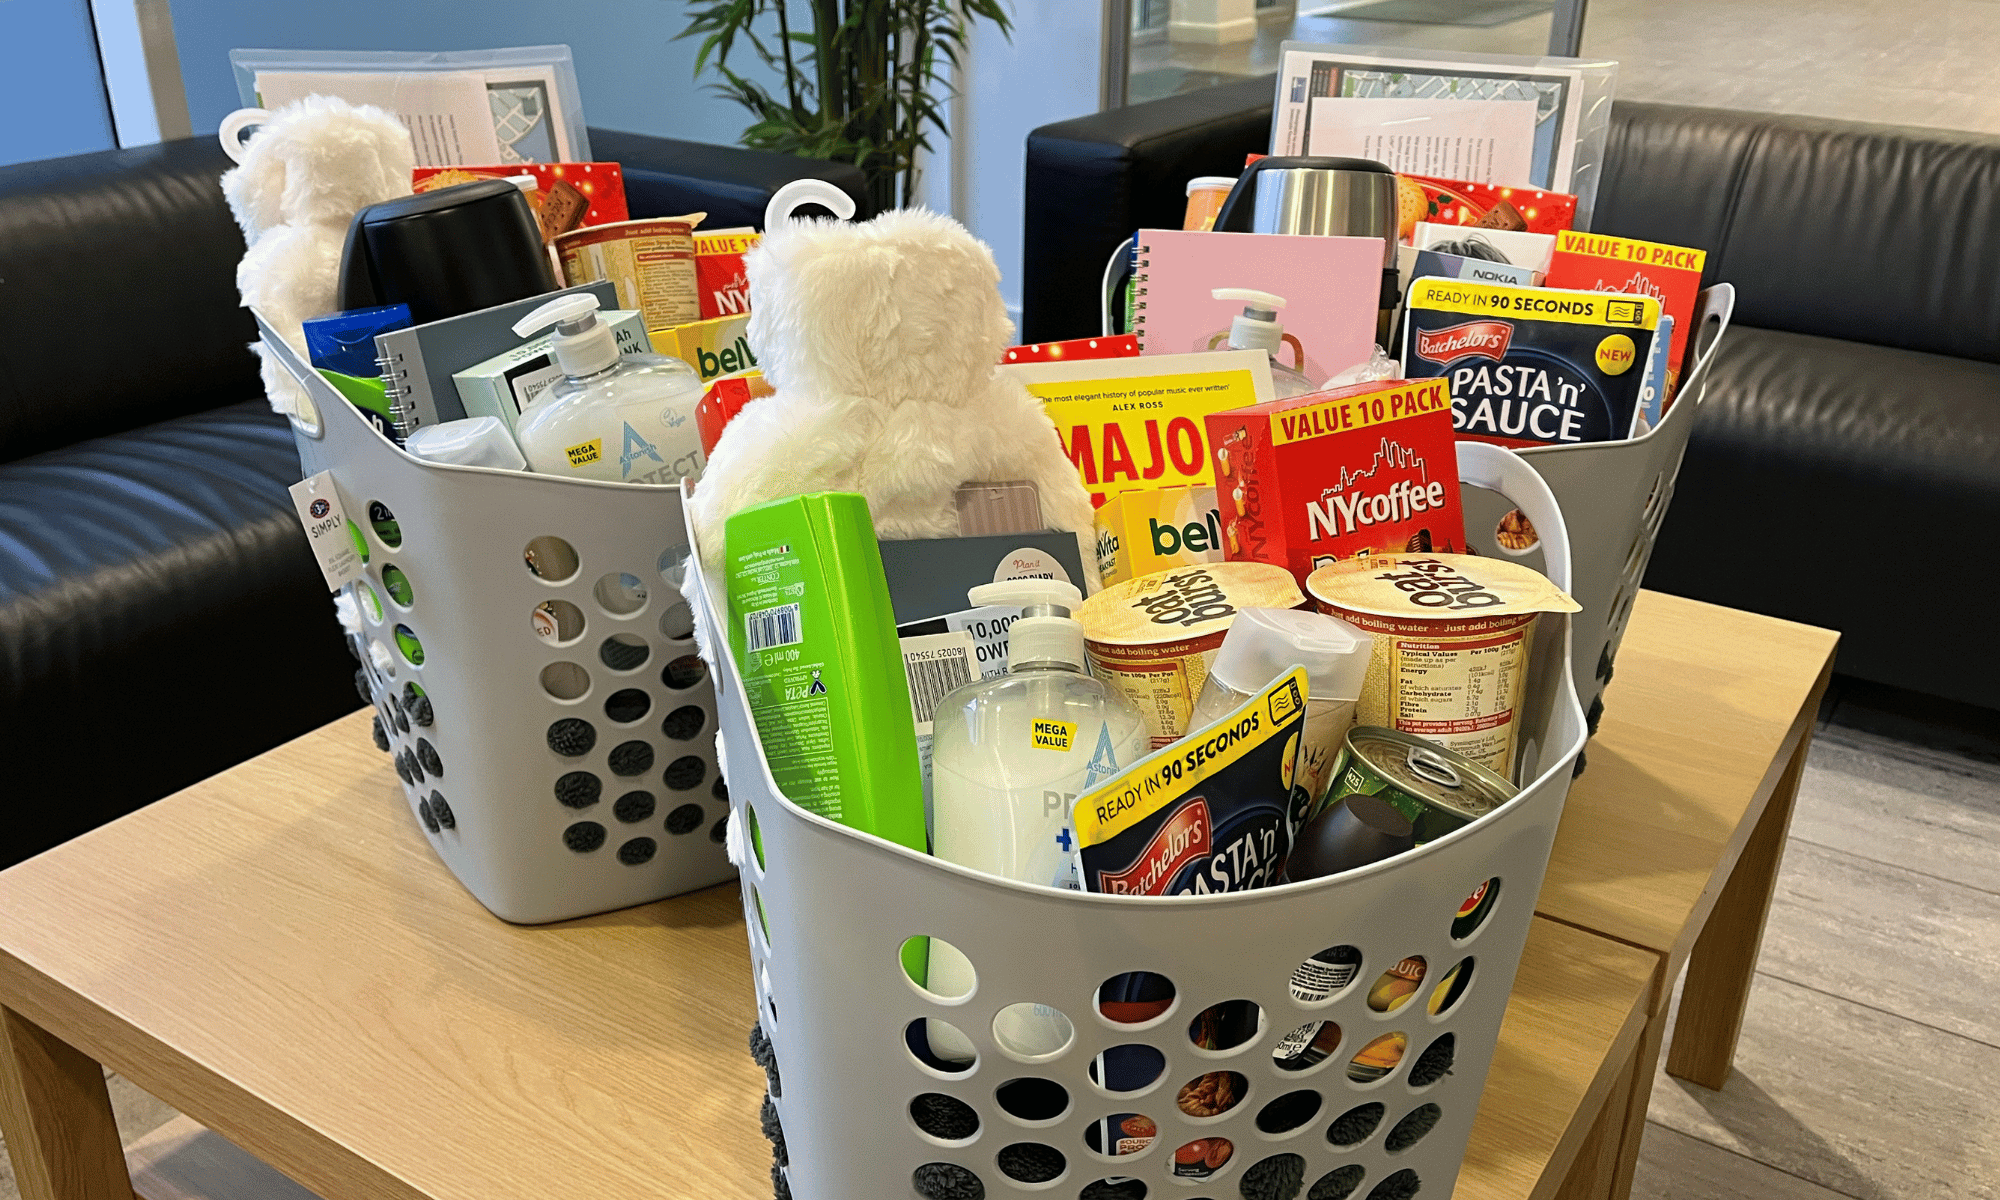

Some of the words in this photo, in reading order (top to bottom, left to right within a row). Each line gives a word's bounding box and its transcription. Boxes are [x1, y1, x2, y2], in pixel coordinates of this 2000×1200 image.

[1564, 234, 1622, 260] VALUE
[1626, 246, 1649, 262] 10
[1651, 250, 1699, 270] PACK
[1472, 269, 1519, 286] NOKIA
[1426, 289, 1471, 306] READY
[1472, 295, 1488, 306] IN
[1490, 295, 1510, 309] 90
[1512, 298, 1595, 317] SECONDS
[615, 329, 632, 345] Ah
[1419, 330, 1504, 355] Batchelors
[1599, 347, 1633, 363] NEW
[1451, 364, 1552, 402] PASTA
[1053, 395, 1073, 403] most
[1073, 393, 1102, 404] elegant
[1102, 390, 1127, 401] history
[1128, 389, 1137, 398] of
[1137, 388, 1165, 399] popular
[1165, 386, 1187, 396] music
[1187, 386, 1204, 394] ever
[1112, 403, 1137, 412] ALEX
[1139, 400, 1164, 410] ROSS
[1280, 404, 1354, 442] VALUE
[1357, 397, 1386, 425] 10
[1389, 384, 1445, 418] PACK
[1450, 398, 1586, 442] SAUCE
[567, 444, 596, 458] MEGA
[570, 452, 599, 465] VALUE
[619, 443, 657, 465] Astonish
[1304, 479, 1445, 542] NYcoffee
[311, 513, 342, 540] SIMPLY
[1148, 508, 1222, 557] bel
[1344, 612, 1361, 626] add
[1361, 617, 1396, 632] boiling
[1397, 623, 1430, 633] water
[1443, 623, 1467, 633] Just
[1468, 621, 1487, 632] add
[1488, 614, 1518, 630] boiling
[786, 649, 800, 663] 400
[1111, 646, 1126, 656] add
[1126, 646, 1160, 658] boiling
[1160, 644, 1190, 654] water
[1400, 642, 1440, 650] Nutrition
[1400, 650, 1430, 658] Typical
[1034, 722, 1067, 737] MEGA
[1035, 735, 1068, 748] VALUE
[1096, 783, 1142, 825] READY
[1144, 773, 1162, 797] IN
[1162, 759, 1183, 786] 90
[1186, 711, 1260, 773] SECONDS
[1111, 818, 1202, 896] Batchelors
[1178, 833, 1258, 897] ASTA
